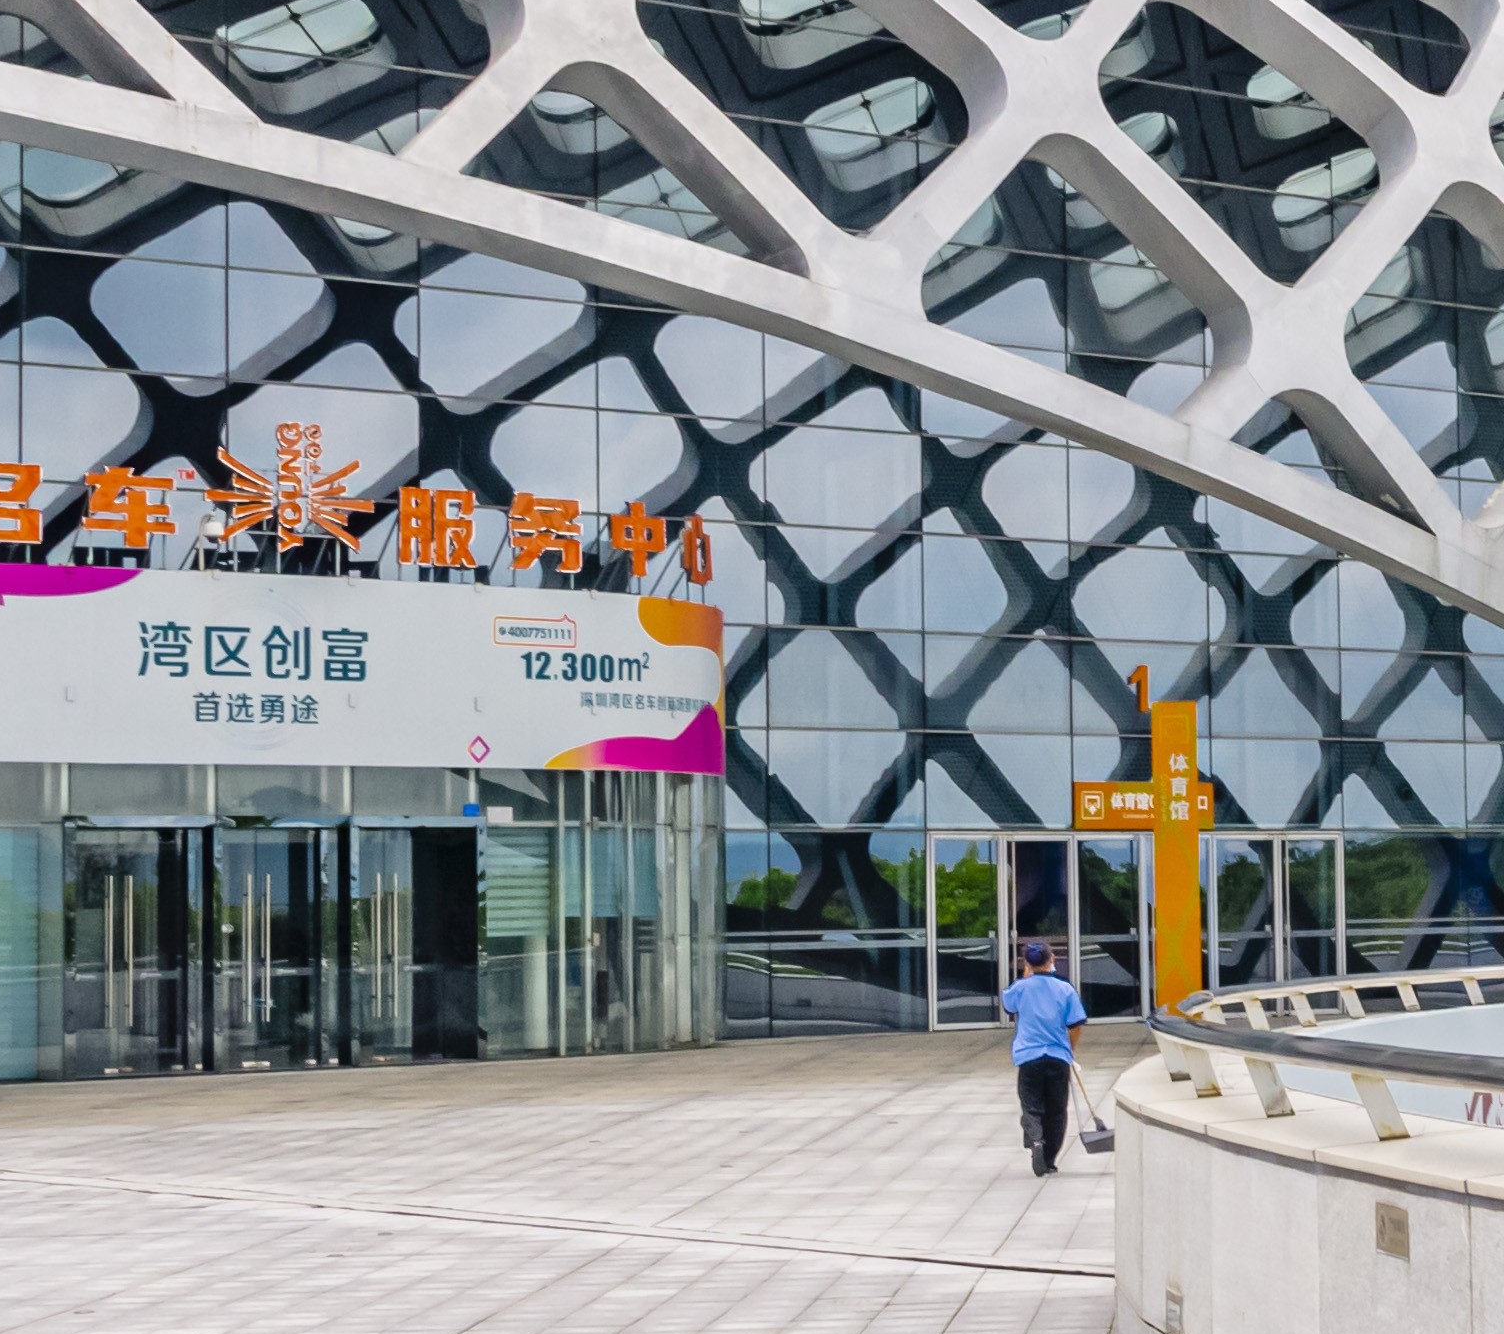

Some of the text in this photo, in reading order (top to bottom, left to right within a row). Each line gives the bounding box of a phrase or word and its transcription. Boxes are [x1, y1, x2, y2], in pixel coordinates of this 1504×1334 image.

[276, 422, 303, 554] YOUNG
[138, 621, 369, 682] 湾区创富
[192, 691, 320, 725] 首选勇途
[1128, 664, 1151, 713] 1
[1168, 753, 1190, 821] 体育馆
